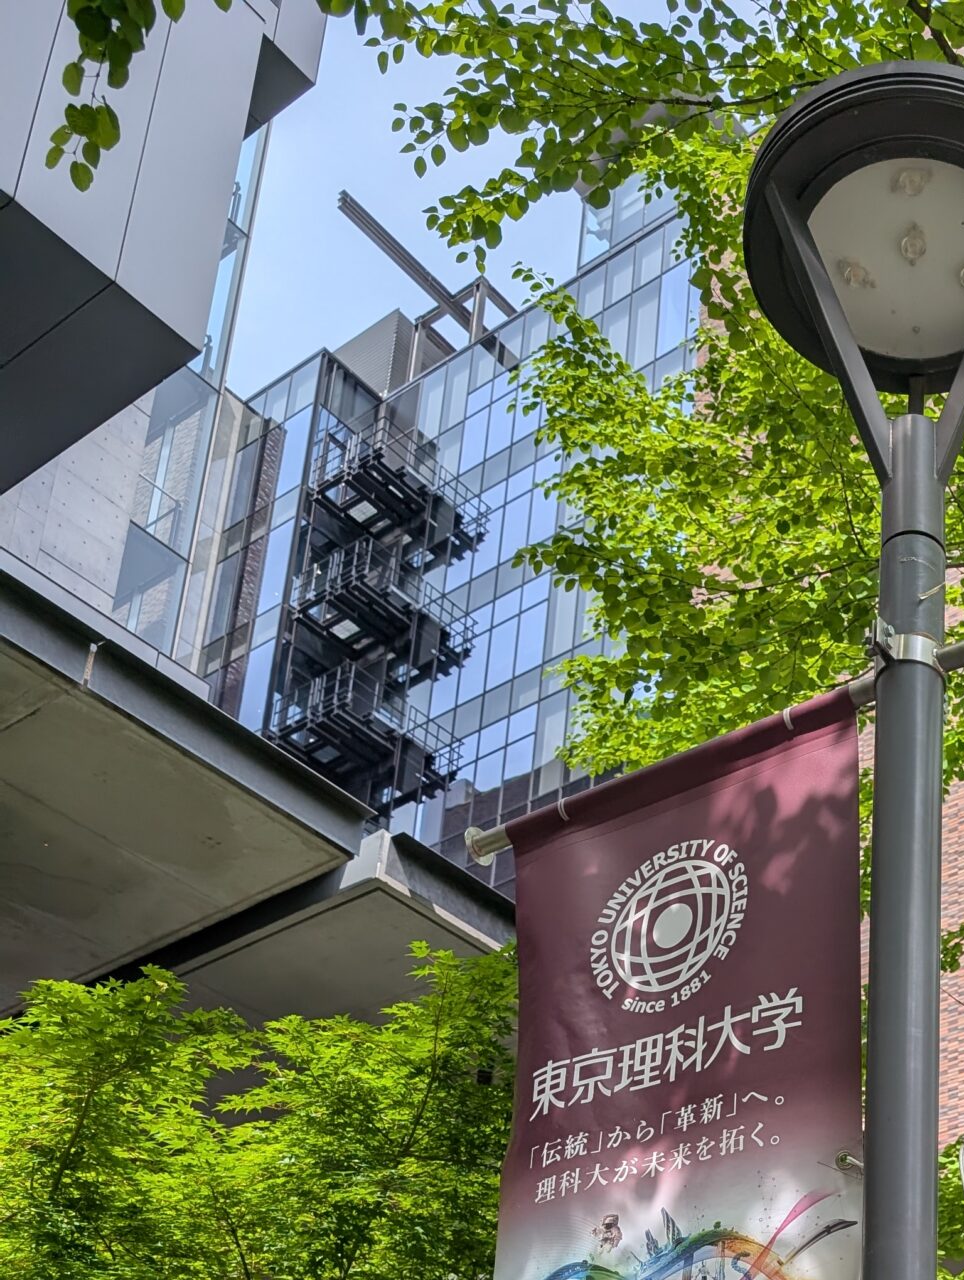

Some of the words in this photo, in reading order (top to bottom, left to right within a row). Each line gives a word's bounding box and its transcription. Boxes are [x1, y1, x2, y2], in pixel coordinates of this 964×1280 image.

[598, 839, 715, 924] UNIVERSITY
[713, 844, 738, 866] OF
[712, 862, 748, 961] SCIENCE
[590, 930, 620, 1000] TOKYO
[621, 997, 665, 1013] since
[670, 970, 711, 1007] 1881
[529, 987, 803, 1122] 東京理科大学
[534, 1122, 780, 1204] 理科大が未来を拓く。
